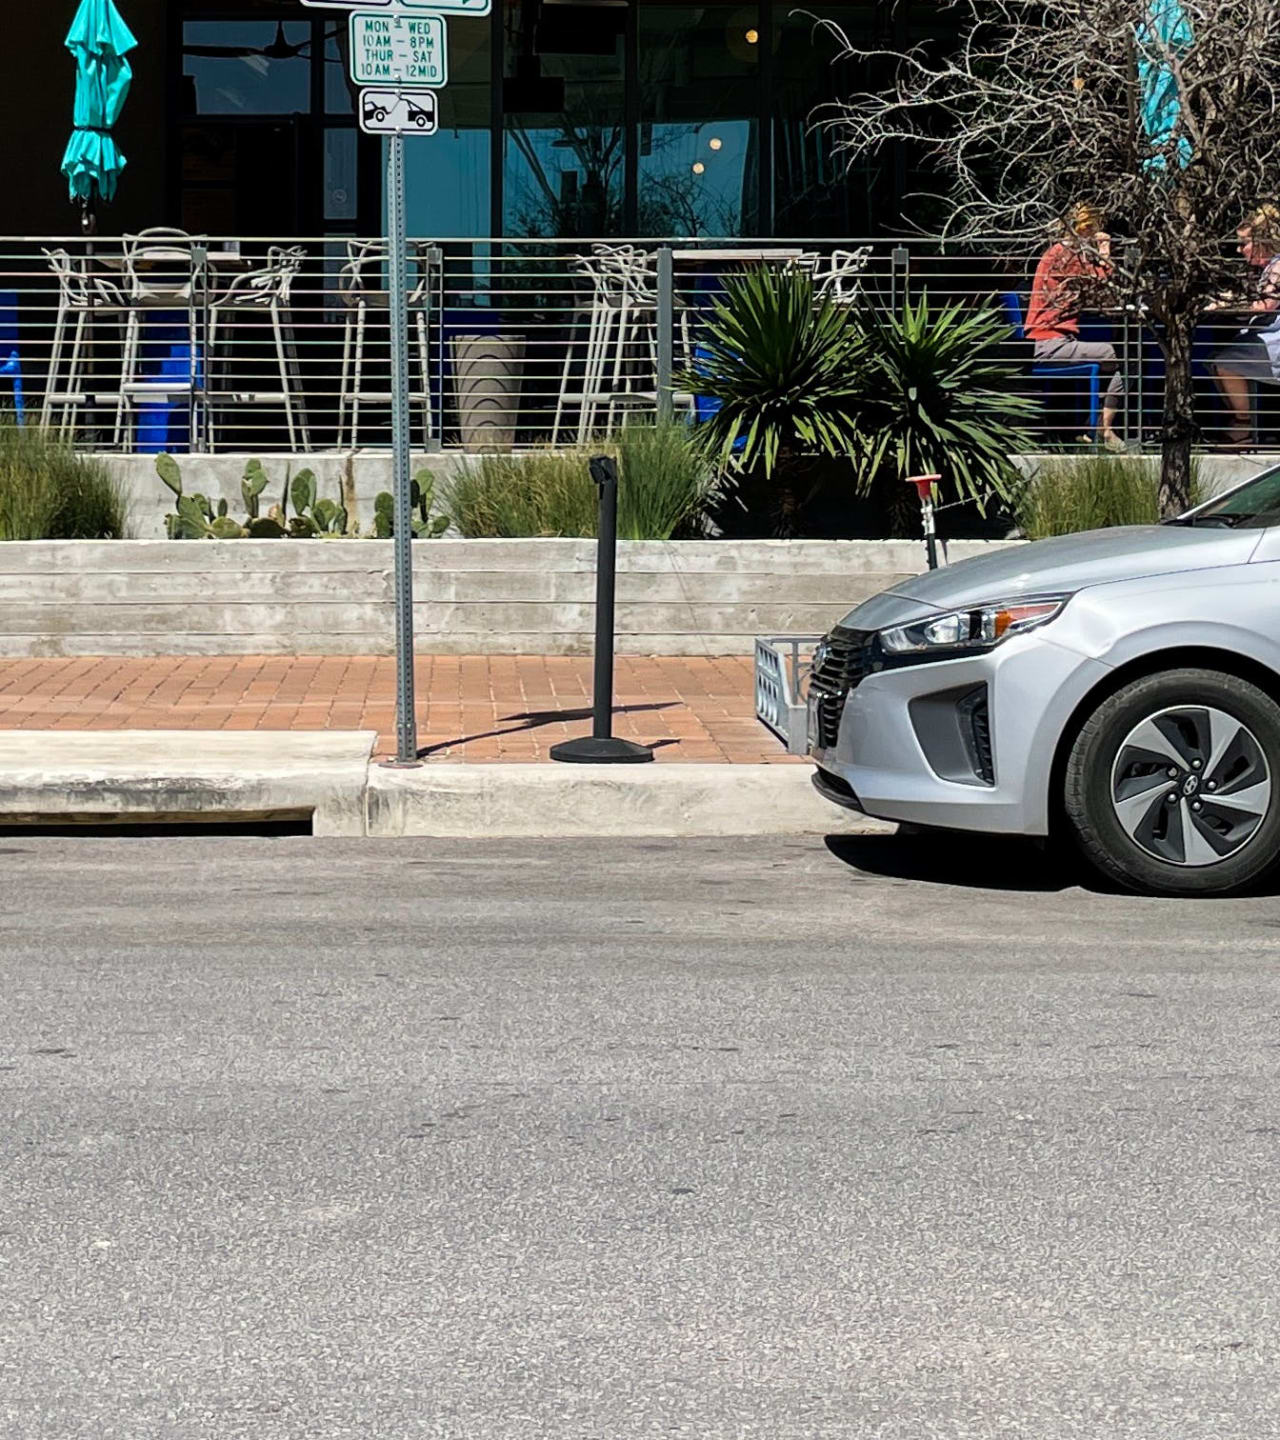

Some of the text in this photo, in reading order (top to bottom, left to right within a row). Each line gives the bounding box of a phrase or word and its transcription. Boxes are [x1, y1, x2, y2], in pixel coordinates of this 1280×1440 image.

[365, 20, 389, 33] MON
[408, 22, 431, 34] WED
[362, 35, 392, 47] 10AM
[410, 36, 434, 49] 8PM
[364, 48, 394, 62] THUR
[413, 50, 433, 63] SAT
[361, 63, 391, 76] 10AM
[406, 64, 438, 78] 12MID
